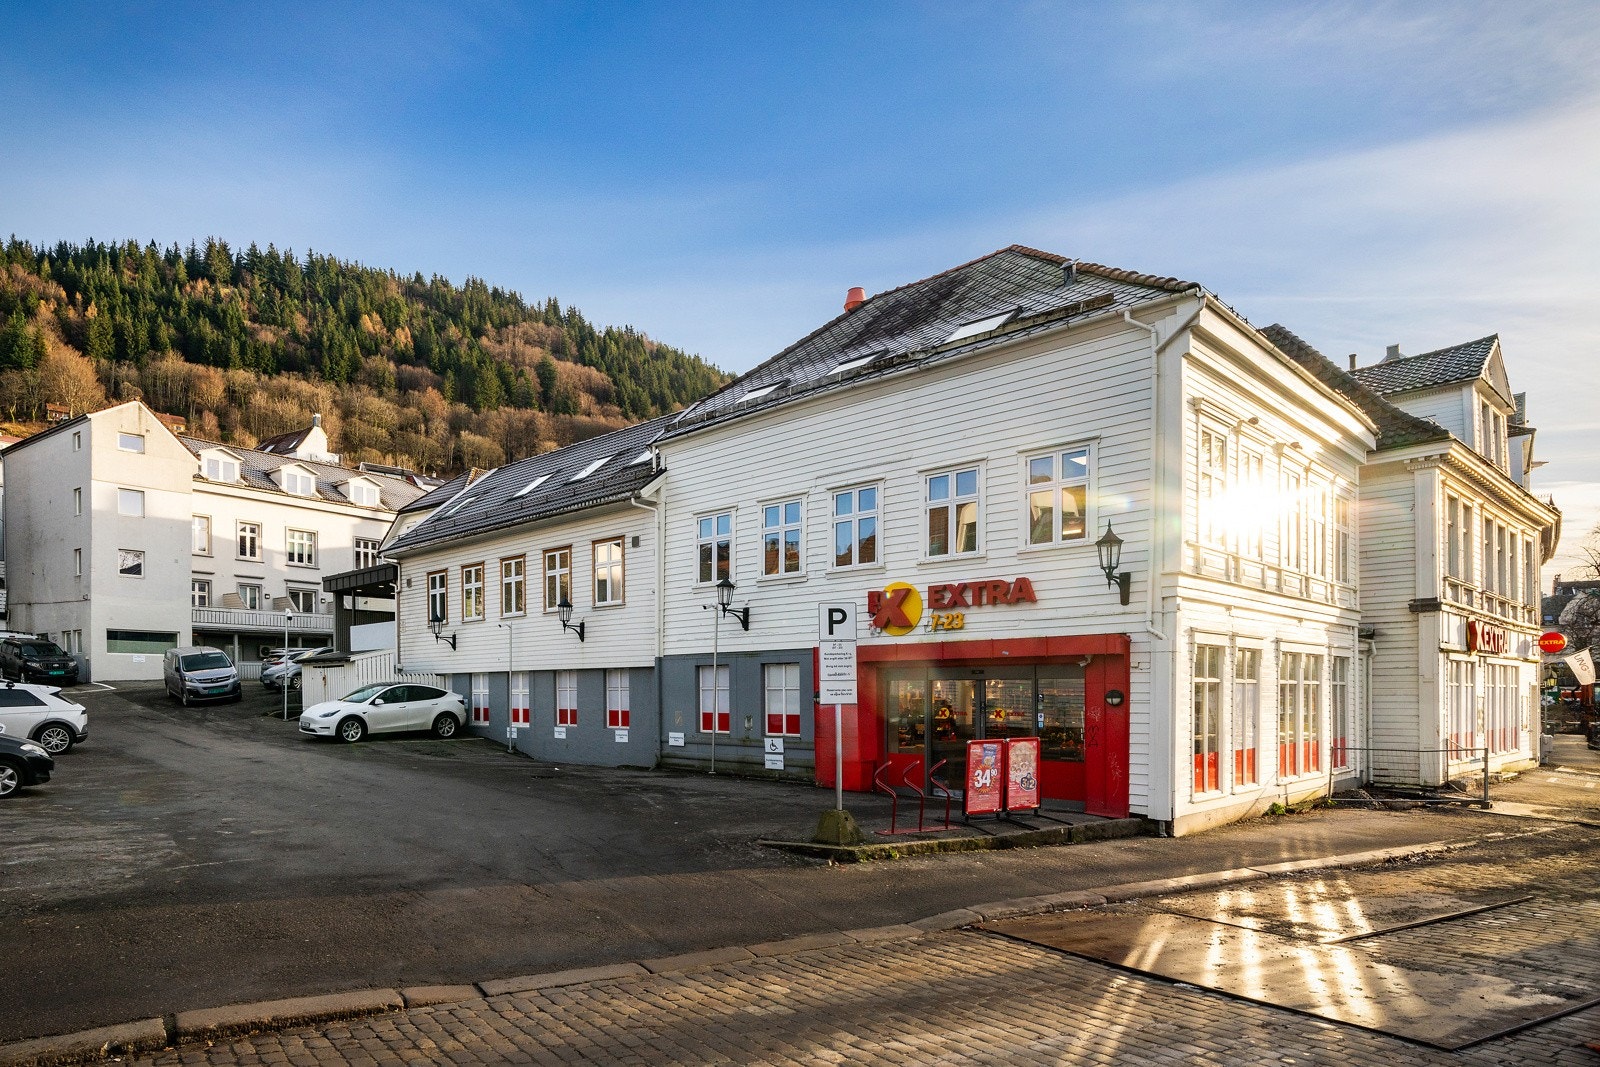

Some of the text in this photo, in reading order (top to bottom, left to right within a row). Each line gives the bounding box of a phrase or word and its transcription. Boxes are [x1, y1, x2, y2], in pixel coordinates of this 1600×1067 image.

[927, 577, 1037, 609] EXTRA
[828, 608, 847, 635] P
[931, 612, 964, 632] 7-23
[1483, 624, 1509, 654] EXTRA
